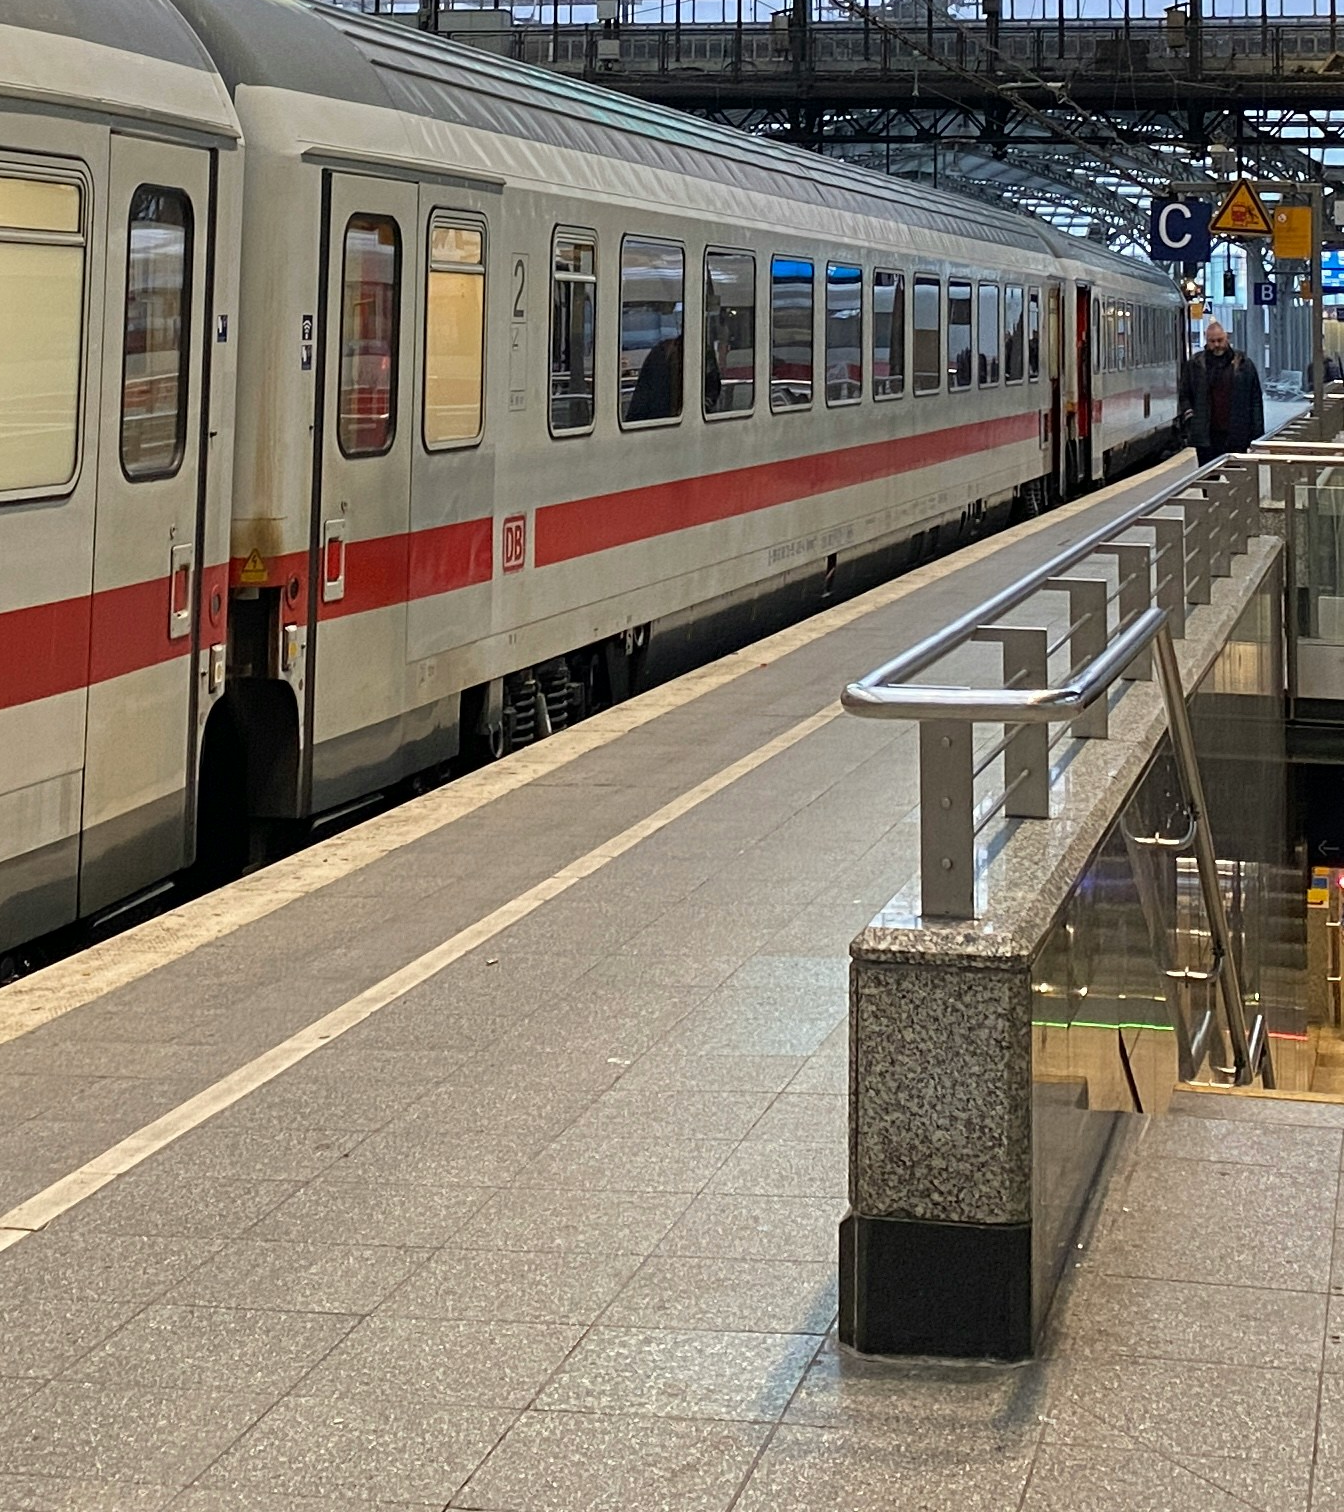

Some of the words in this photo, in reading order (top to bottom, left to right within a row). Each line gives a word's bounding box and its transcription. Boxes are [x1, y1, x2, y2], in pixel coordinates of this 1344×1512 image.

[1158, 203, 1193, 249] C
[513, 258, 525, 318] 2
[1261, 285, 1274, 301] B
[504, 526, 524, 565] DB
